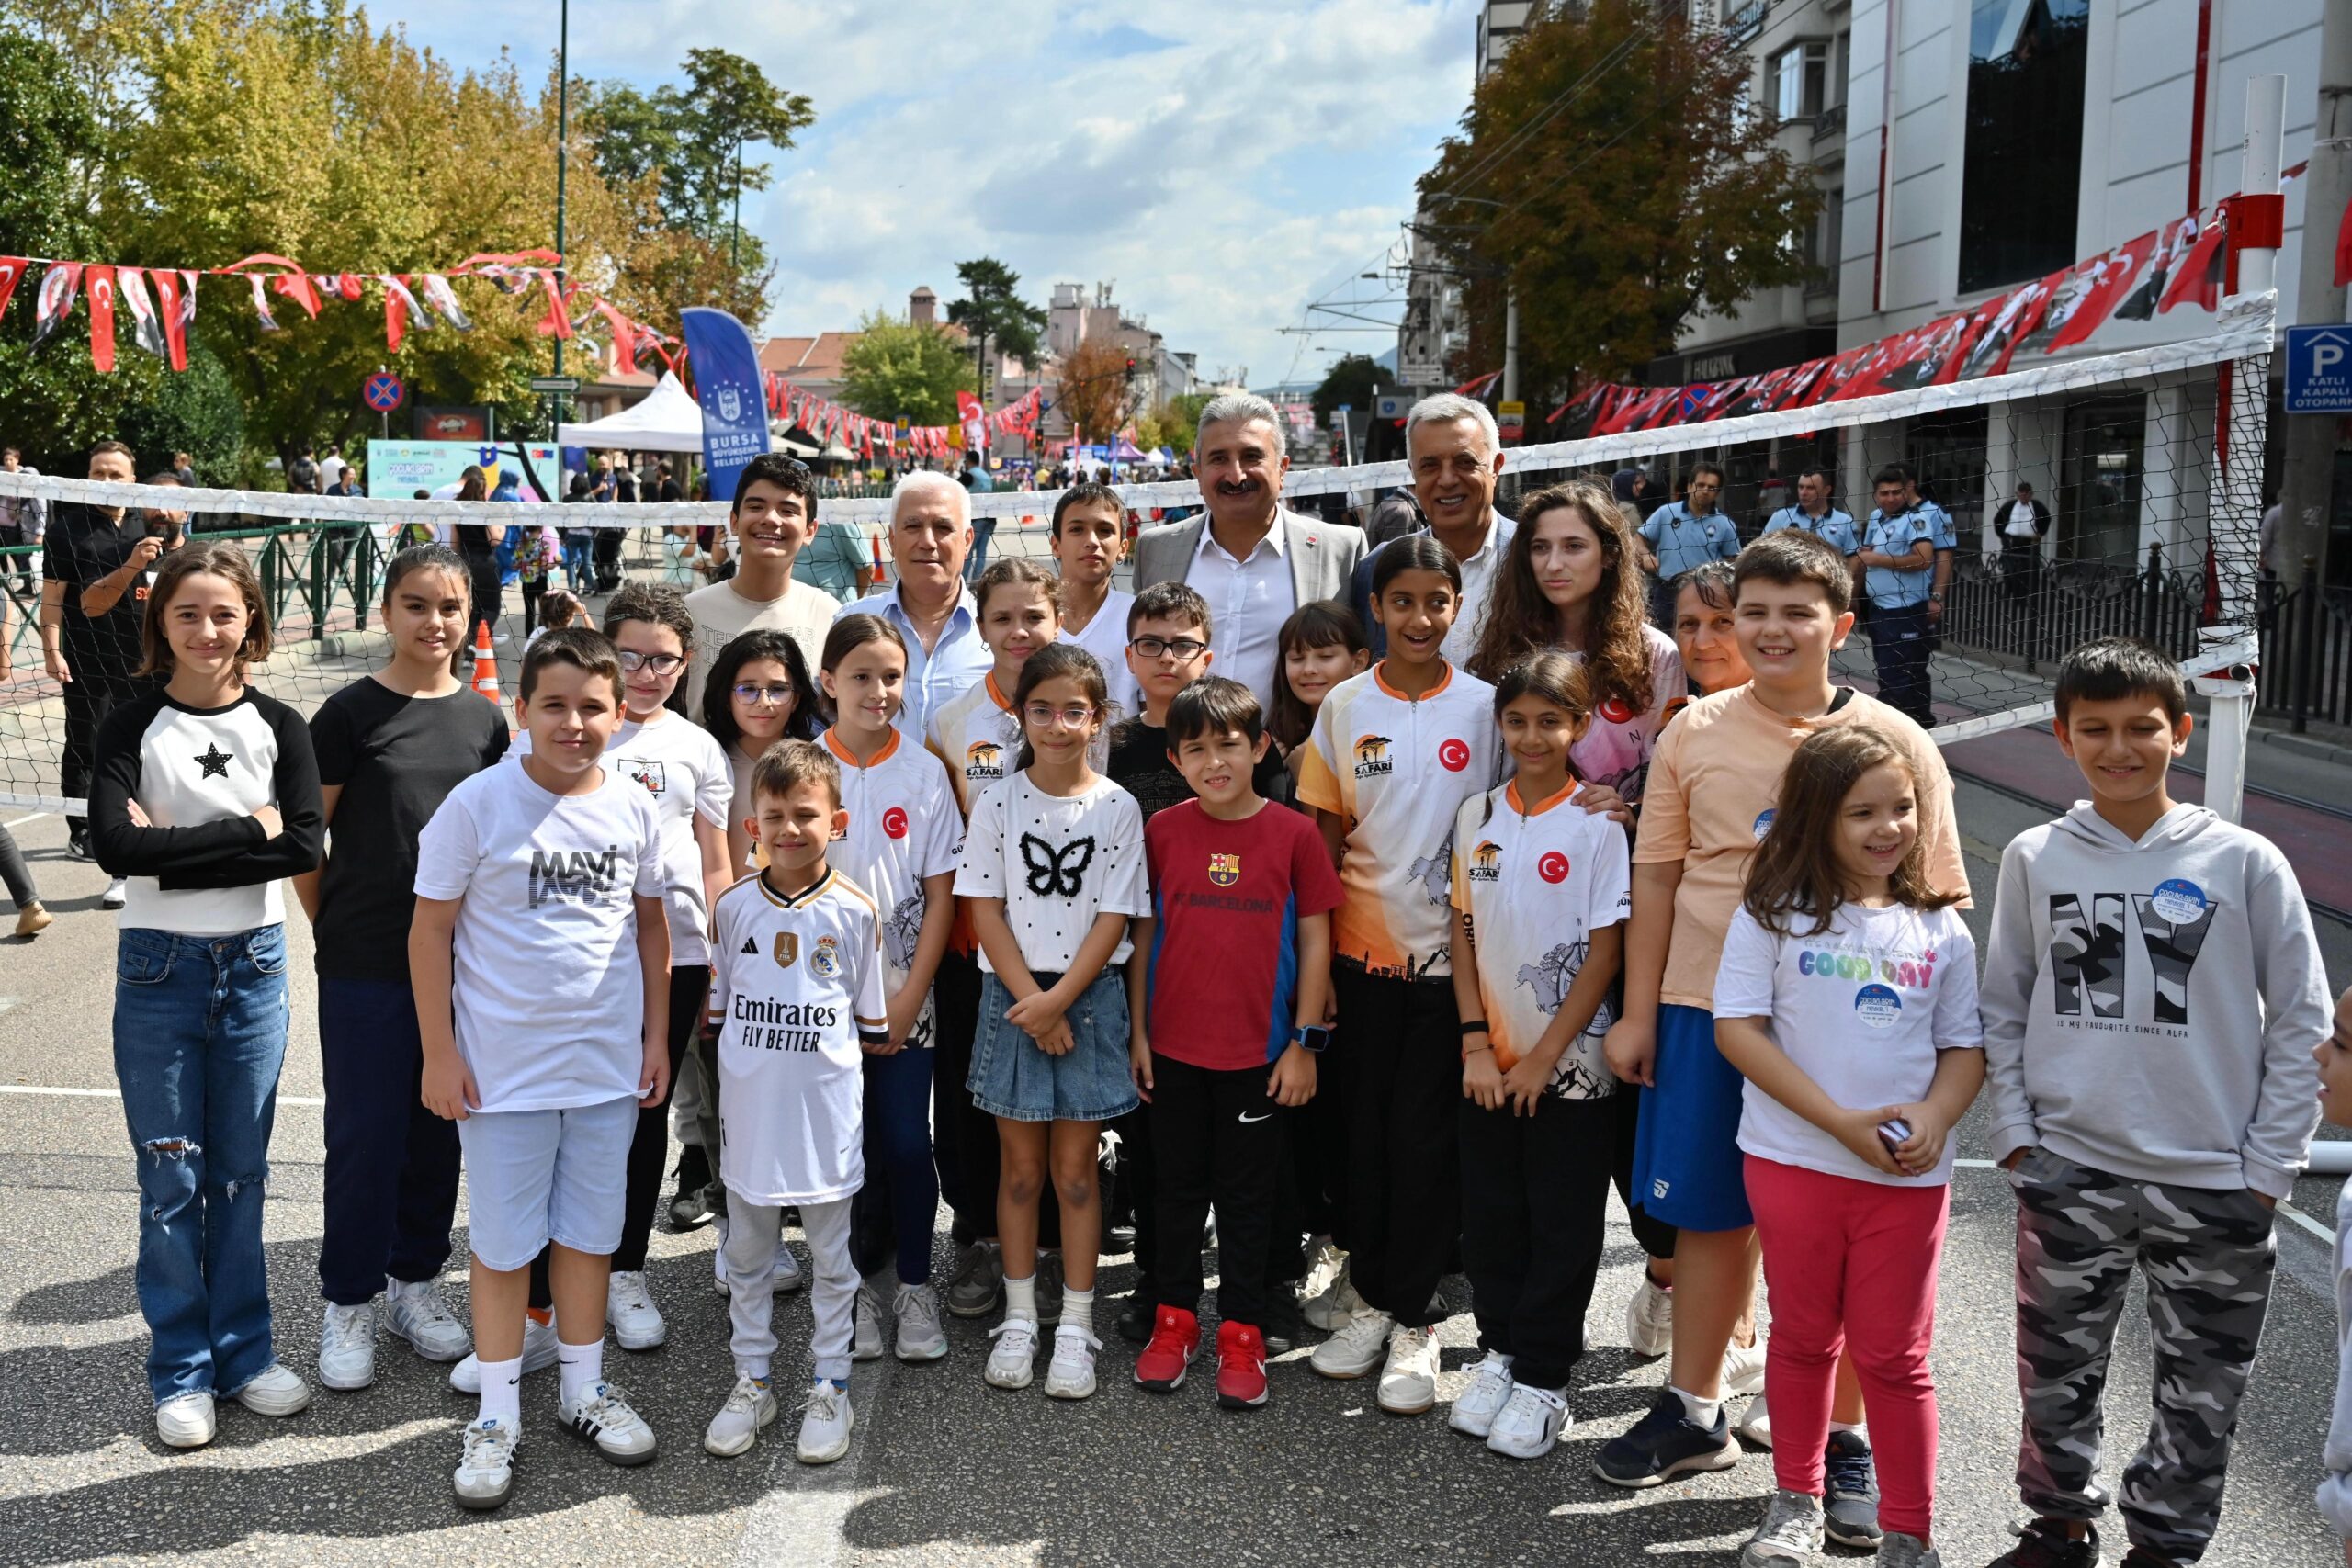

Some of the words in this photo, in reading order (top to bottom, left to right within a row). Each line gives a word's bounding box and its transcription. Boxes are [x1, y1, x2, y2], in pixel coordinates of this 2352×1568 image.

[2313, 344, 2344, 376] P
[2308, 377, 2345, 386] KATLI
[2302, 387, 2350, 397] KAPALI
[710, 434, 759, 449] BURSA
[714, 456, 753, 467] BELEDİY
[1354, 761, 1393, 775] SAFARI
[1190, 893, 1272, 912] BARCELONA
[2049, 893, 2219, 1025] NY
[1799, 951, 1872, 981] GOOD
[1881, 960, 1933, 989] DAY
[735, 994, 837, 1027] Emirates
[2085, 1021, 2130, 1032] FAVOURITE
[2134, 1025, 2161, 1035] SINCE
[2166, 1029, 2188, 1038] ALFA
[742, 1026, 763, 1048] FLY
[765, 1029, 820, 1052] BETTER
